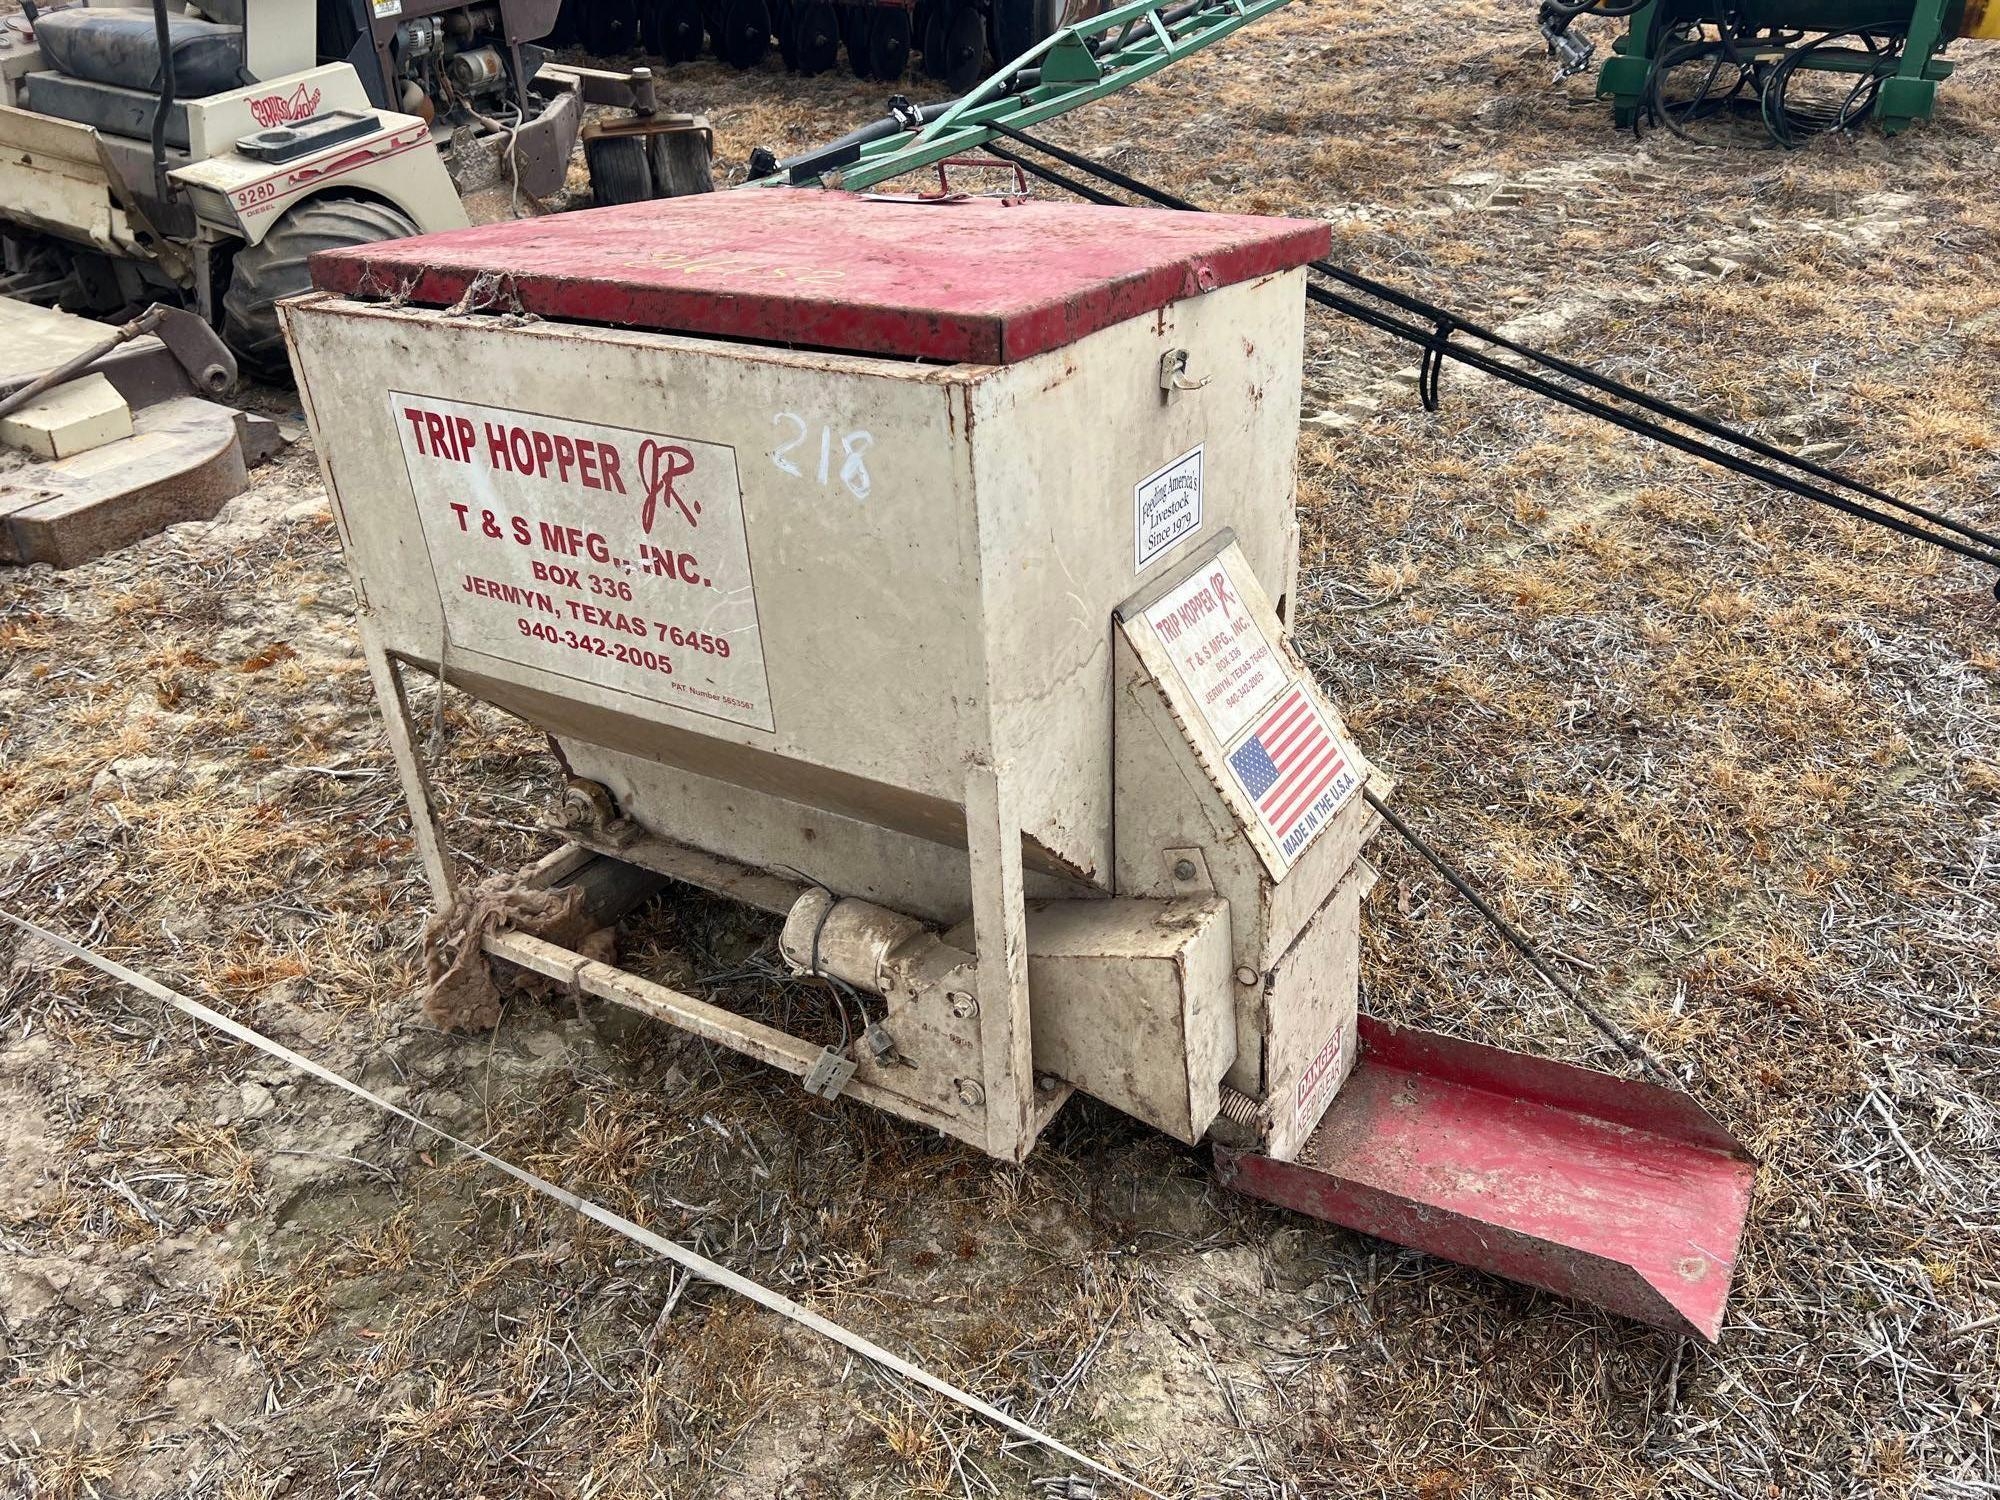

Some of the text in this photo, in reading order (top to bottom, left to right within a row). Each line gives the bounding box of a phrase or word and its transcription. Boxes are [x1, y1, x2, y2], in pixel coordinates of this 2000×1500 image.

[238, 182, 275, 206] 928D
[247, 203, 275, 218] DIESEL
[404, 407, 702, 535] TRIP HOPPER JR.
[772, 411, 874, 499] 218
[1168, 470, 1198, 495] America's
[1148, 511, 1192, 551] Since 1979
[1150, 491, 1190, 530] Livestock
[450, 501, 470, 532] T
[481, 509, 504, 539] &
[511, 515, 533, 546] S
[639, 543, 712, 587] INC.
[531, 560, 632, 602] BOX 336
[462, 575, 731, 658] JERMYN, TEXAS 76459
[1155, 612, 1182, 644] TRIP
[1177, 587, 1218, 629] HOPPER
[517, 618, 673, 675] 940-342-2005
[1186, 656, 1196, 672] T
[1194, 651, 1205, 667] &
[1202, 645, 1212, 660] S
[1230, 616, 1251, 638] INC.
[1215, 646, 1242, 673] BOX 336
[671, 681, 686, 692] PAT
[689, 687, 721, 702] Number
[1204, 677, 1234, 705] JERMYN,
[1230, 660, 1253, 682] TEXAS
[1225, 671, 1265, 709] 940-342-2005
[1282, 772, 1355, 858] MADE IN THE U.S.A.
[1299, 1028, 1341, 1100] DANGER
